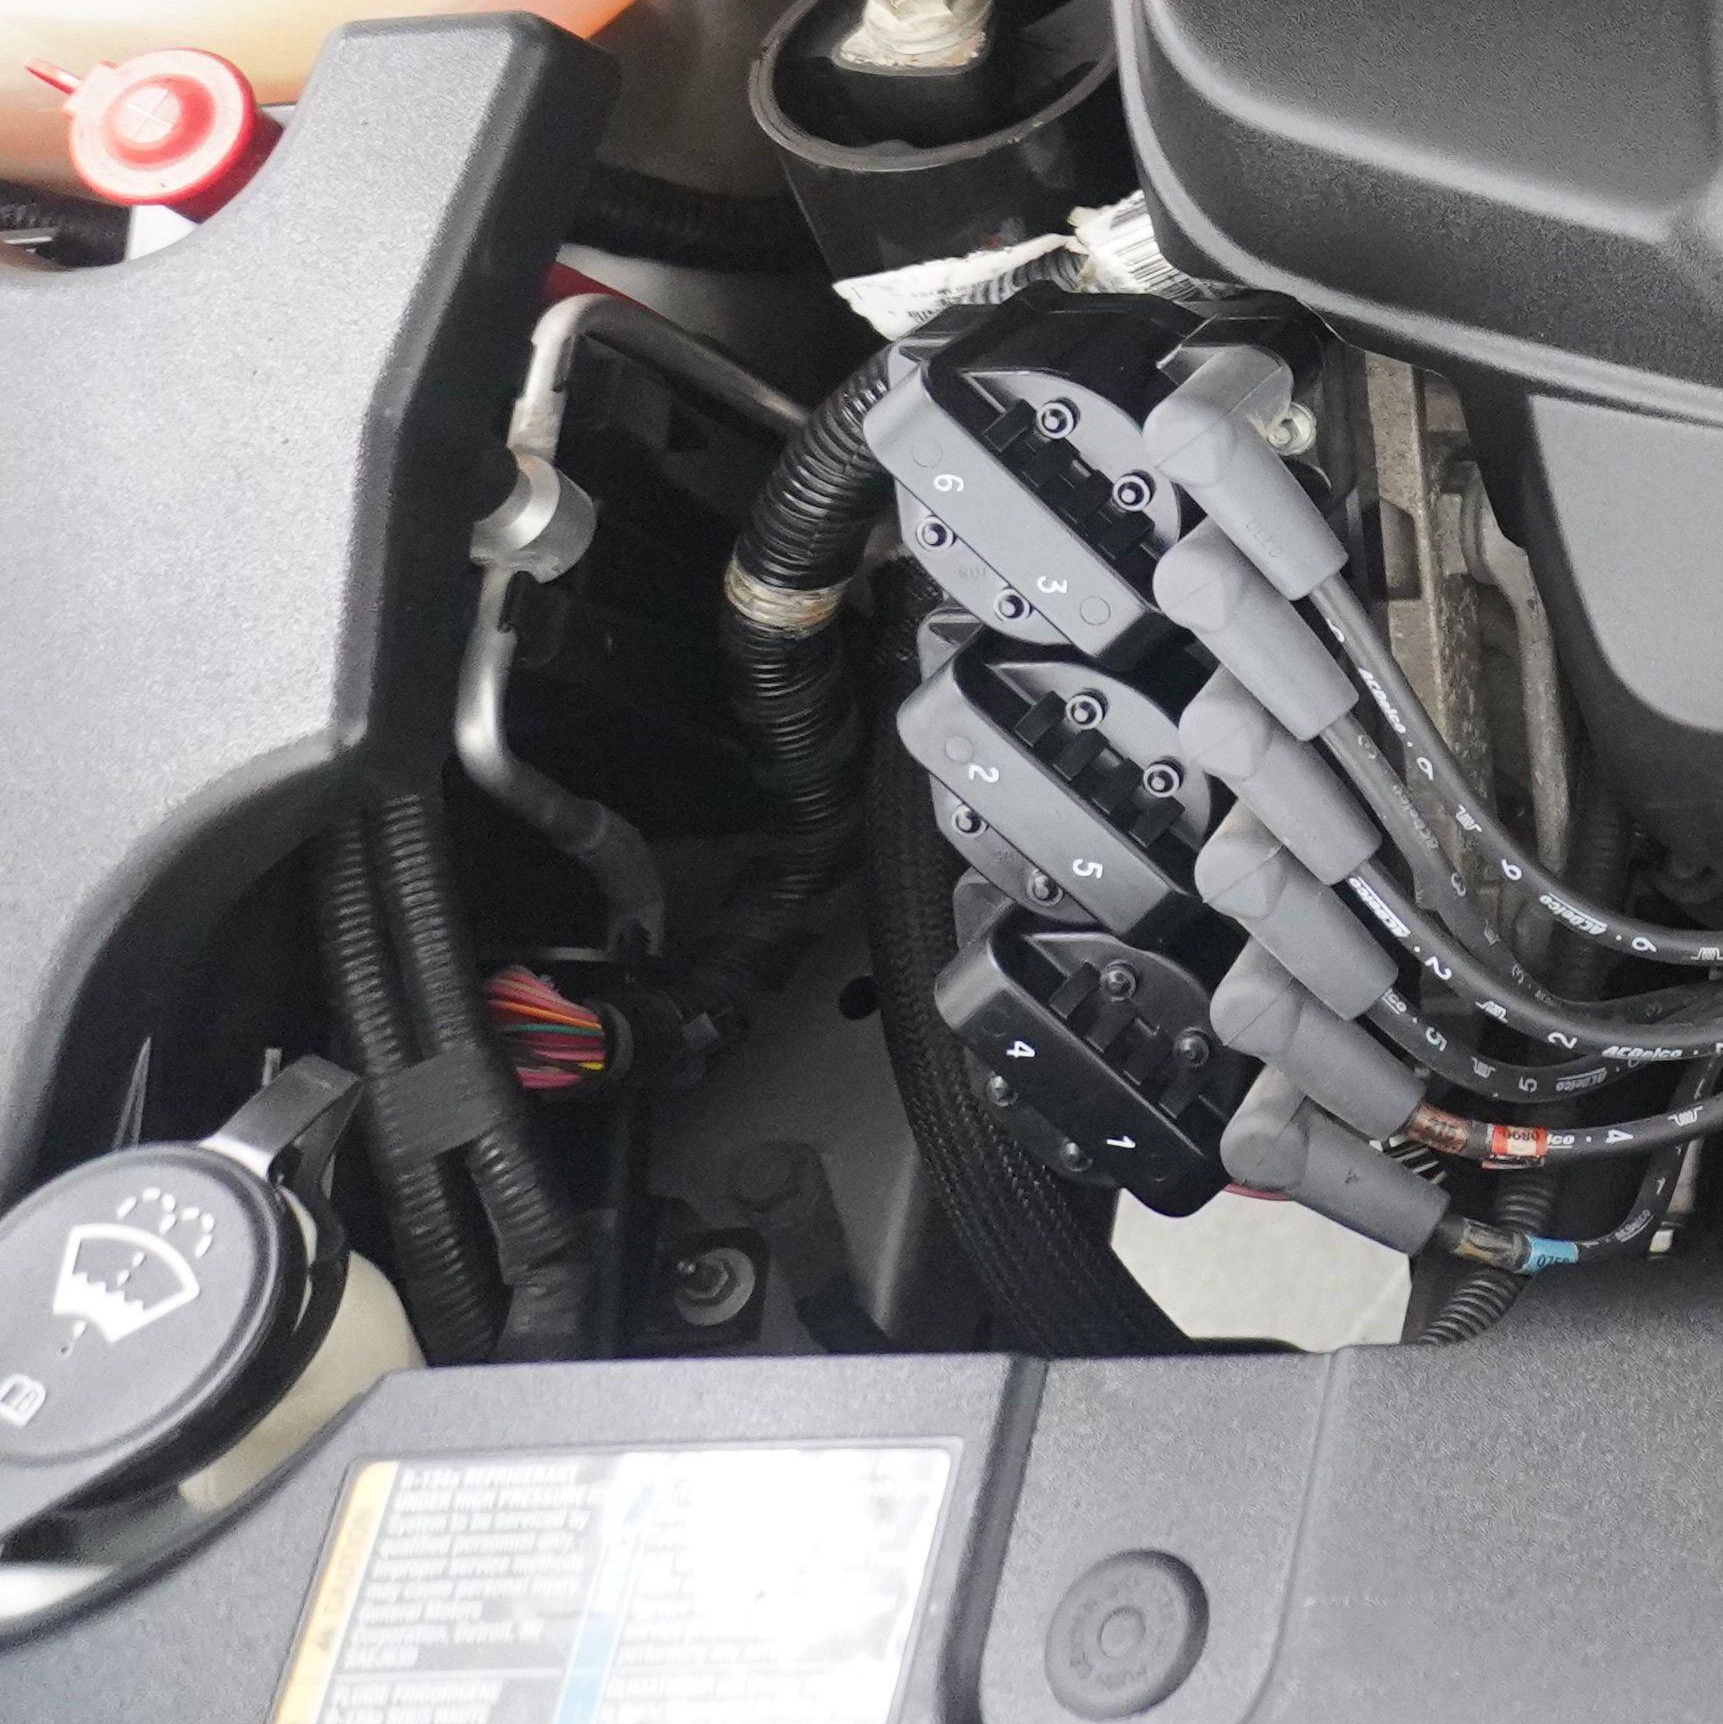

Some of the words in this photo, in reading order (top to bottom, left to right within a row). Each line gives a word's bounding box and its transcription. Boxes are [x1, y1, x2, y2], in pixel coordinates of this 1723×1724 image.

[933, 474, 965, 493] 6
[1036, 576, 1068, 594] 3
[968, 764, 1000, 783] 2
[1072, 858, 1104, 879] 5
[1538, 892, 1608, 936] ACDelco
[1349, 876, 1411, 938] ACDelco
[1424, 955, 1452, 981] 2
[1425, 1026, 1448, 1052] 5
[1547, 1031, 1578, 1050] 2
[1006, 1040, 1036, 1059] 4
[1601, 1045, 1683, 1061] ACDelco
[1518, 1076, 1538, 1093] 5
[1555, 1066, 1608, 1093] ACDelco
[1106, 1136, 1136, 1149] 1
[1605, 1129, 1635, 1144] 4
[463, 1463, 580, 1484] REFRIGERANT
[322, 1507, 375, 1613] CAUTION
